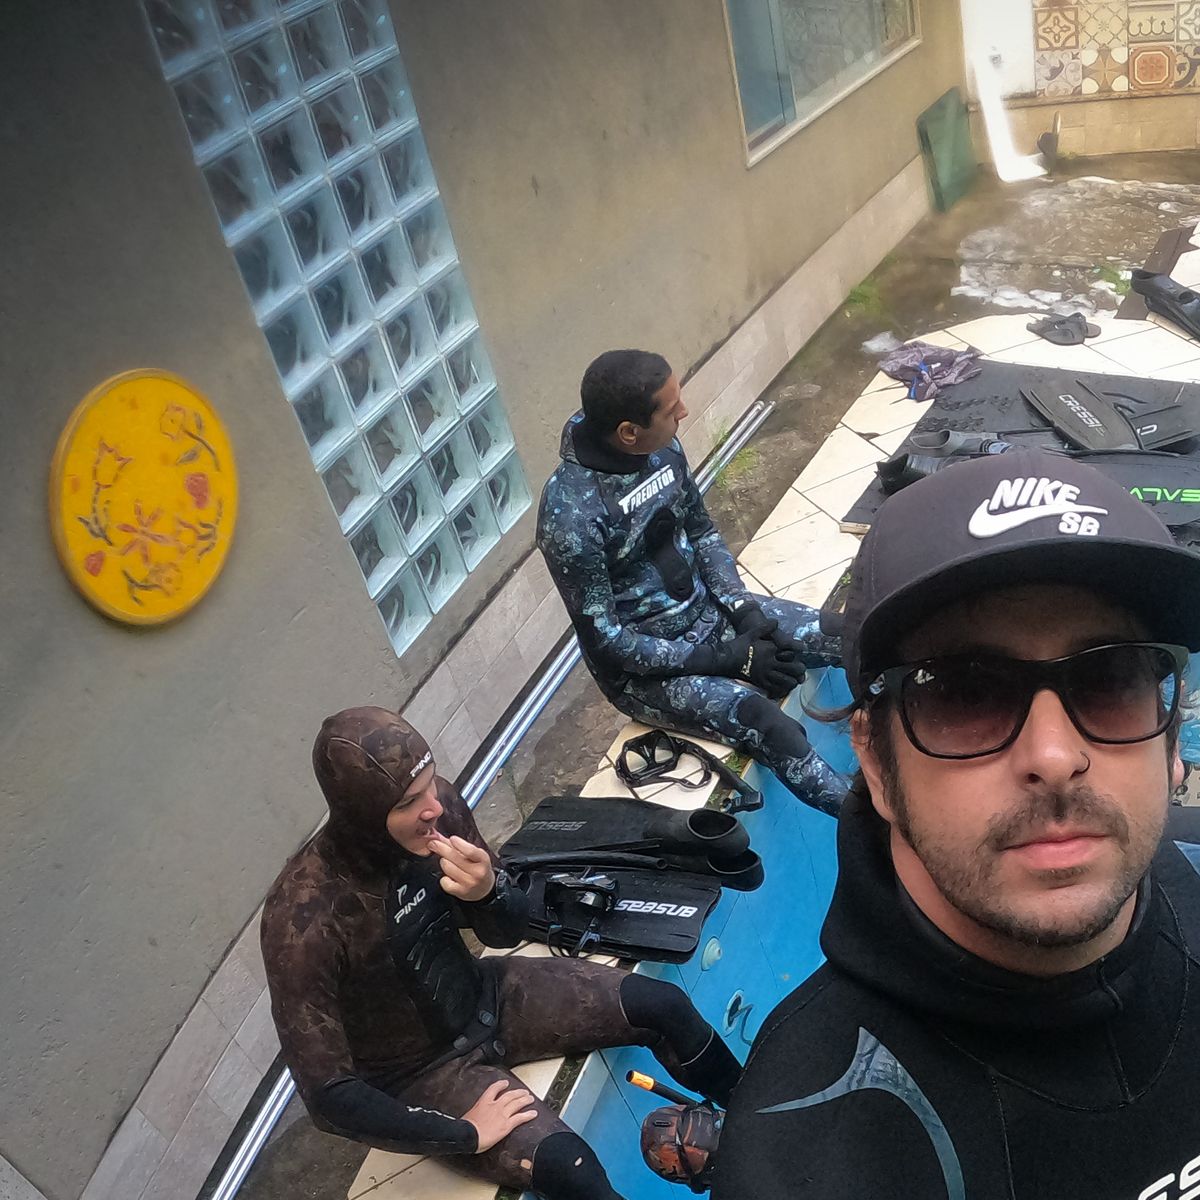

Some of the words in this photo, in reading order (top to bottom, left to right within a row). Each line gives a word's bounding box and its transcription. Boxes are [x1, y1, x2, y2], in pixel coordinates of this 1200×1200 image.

[1058, 394, 1103, 428] CRESSI
[988, 477, 1081, 511] NIKE
[1058, 511, 1100, 536] SB
[410, 751, 432, 777] PINO
[394, 888, 427, 924] PINO
